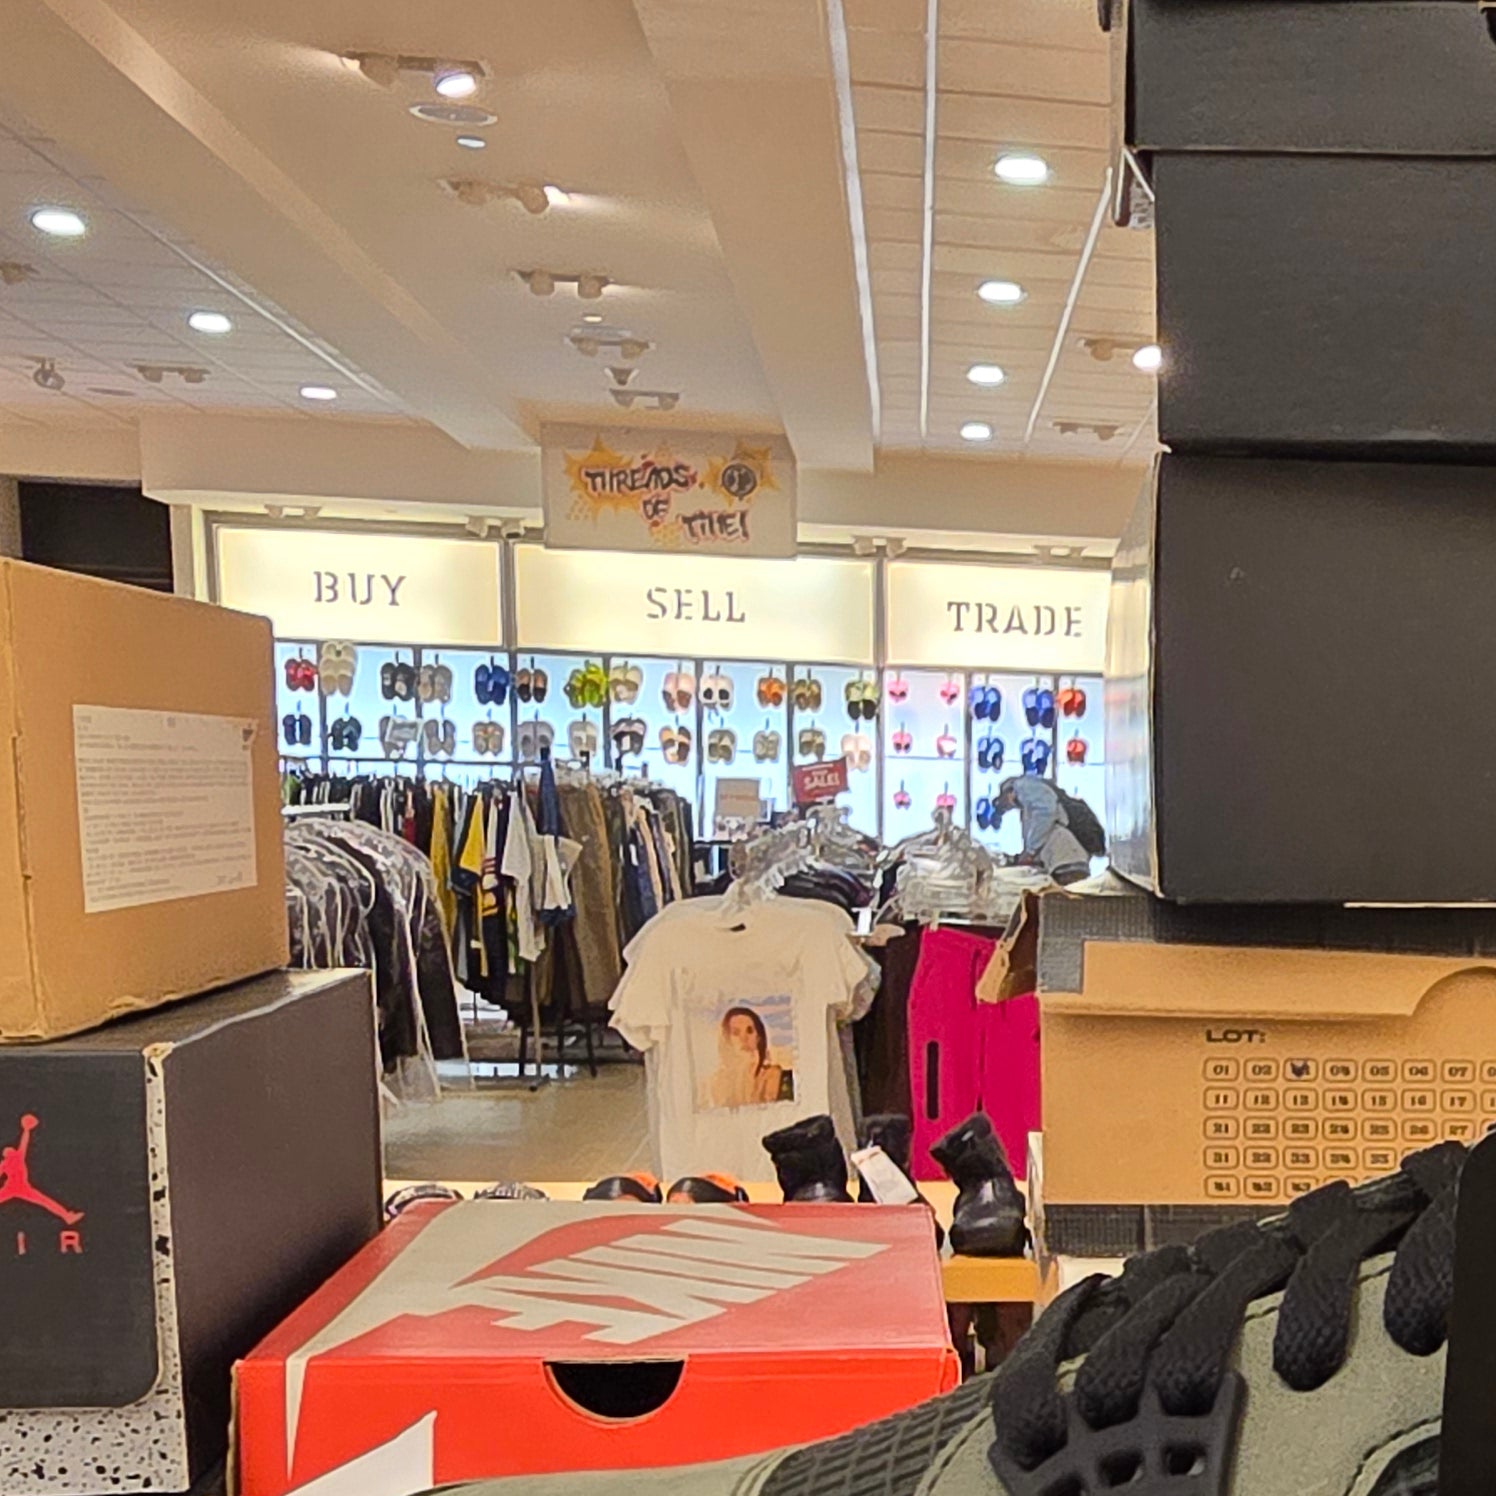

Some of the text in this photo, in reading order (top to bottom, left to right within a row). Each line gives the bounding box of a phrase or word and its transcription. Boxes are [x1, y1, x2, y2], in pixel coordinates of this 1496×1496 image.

[584, 463, 692, 492] THREADS
[313, 571, 406, 607] BUY
[646, 587, 746, 623] SELL
[946, 601, 1082, 638] TRADE
[1205, 1028, 1267, 1044] LOT:
[1212, 1064, 1230, 1076] 01
[1251, 1064, 1273, 1076] 02
[1329, 1064, 1351, 1077] 04
[1369, 1065, 1390, 1077] 05
[1408, 1065, 1429, 1077] 06
[1447, 1066, 1469, 1078] 07
[450, 1218, 893, 1345] NIKE
